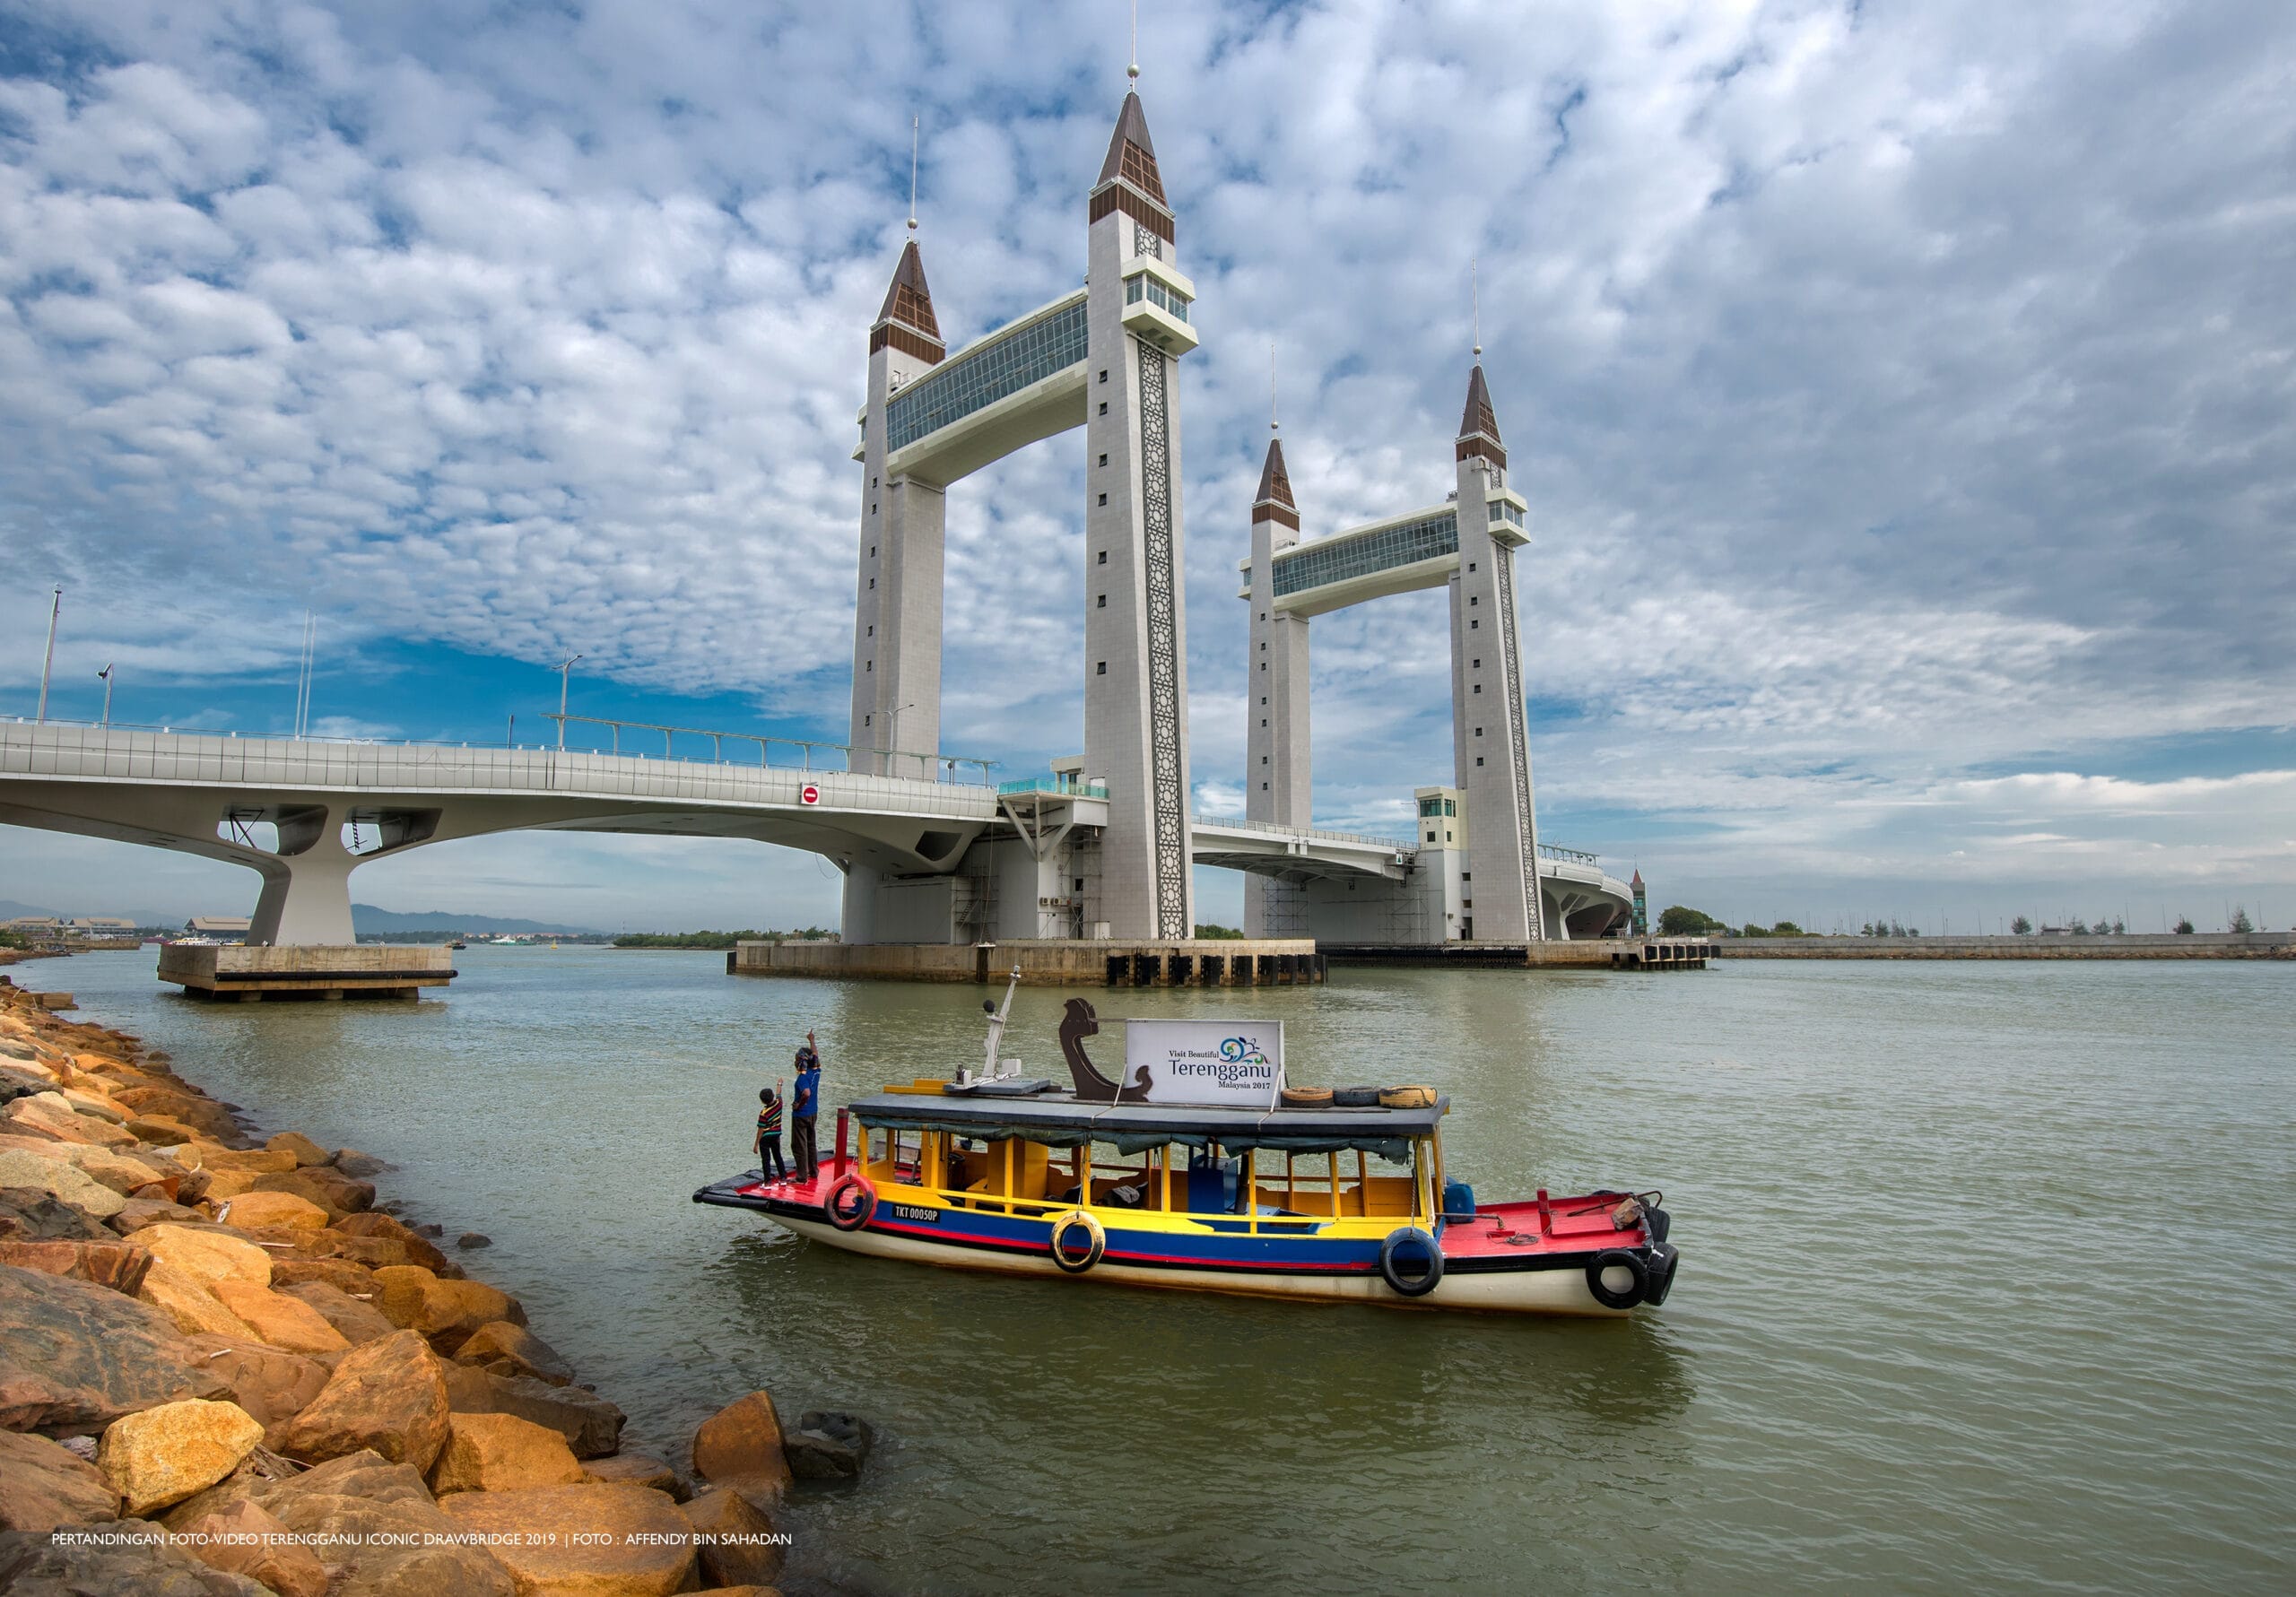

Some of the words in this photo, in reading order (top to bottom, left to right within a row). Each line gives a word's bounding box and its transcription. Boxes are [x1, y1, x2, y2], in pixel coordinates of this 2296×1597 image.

[1169, 1049, 1186, 1058] Visit
[1188, 1050, 1220, 1059] Beautiful
[1168, 1059, 1271, 1081] Terengganu
[1218, 1081, 1251, 1090] Malaysia
[1252, 1082, 1271, 1090] 2017
[895, 1205, 909, 1218] TKT
[909, 1207, 938, 1221] 00050P
